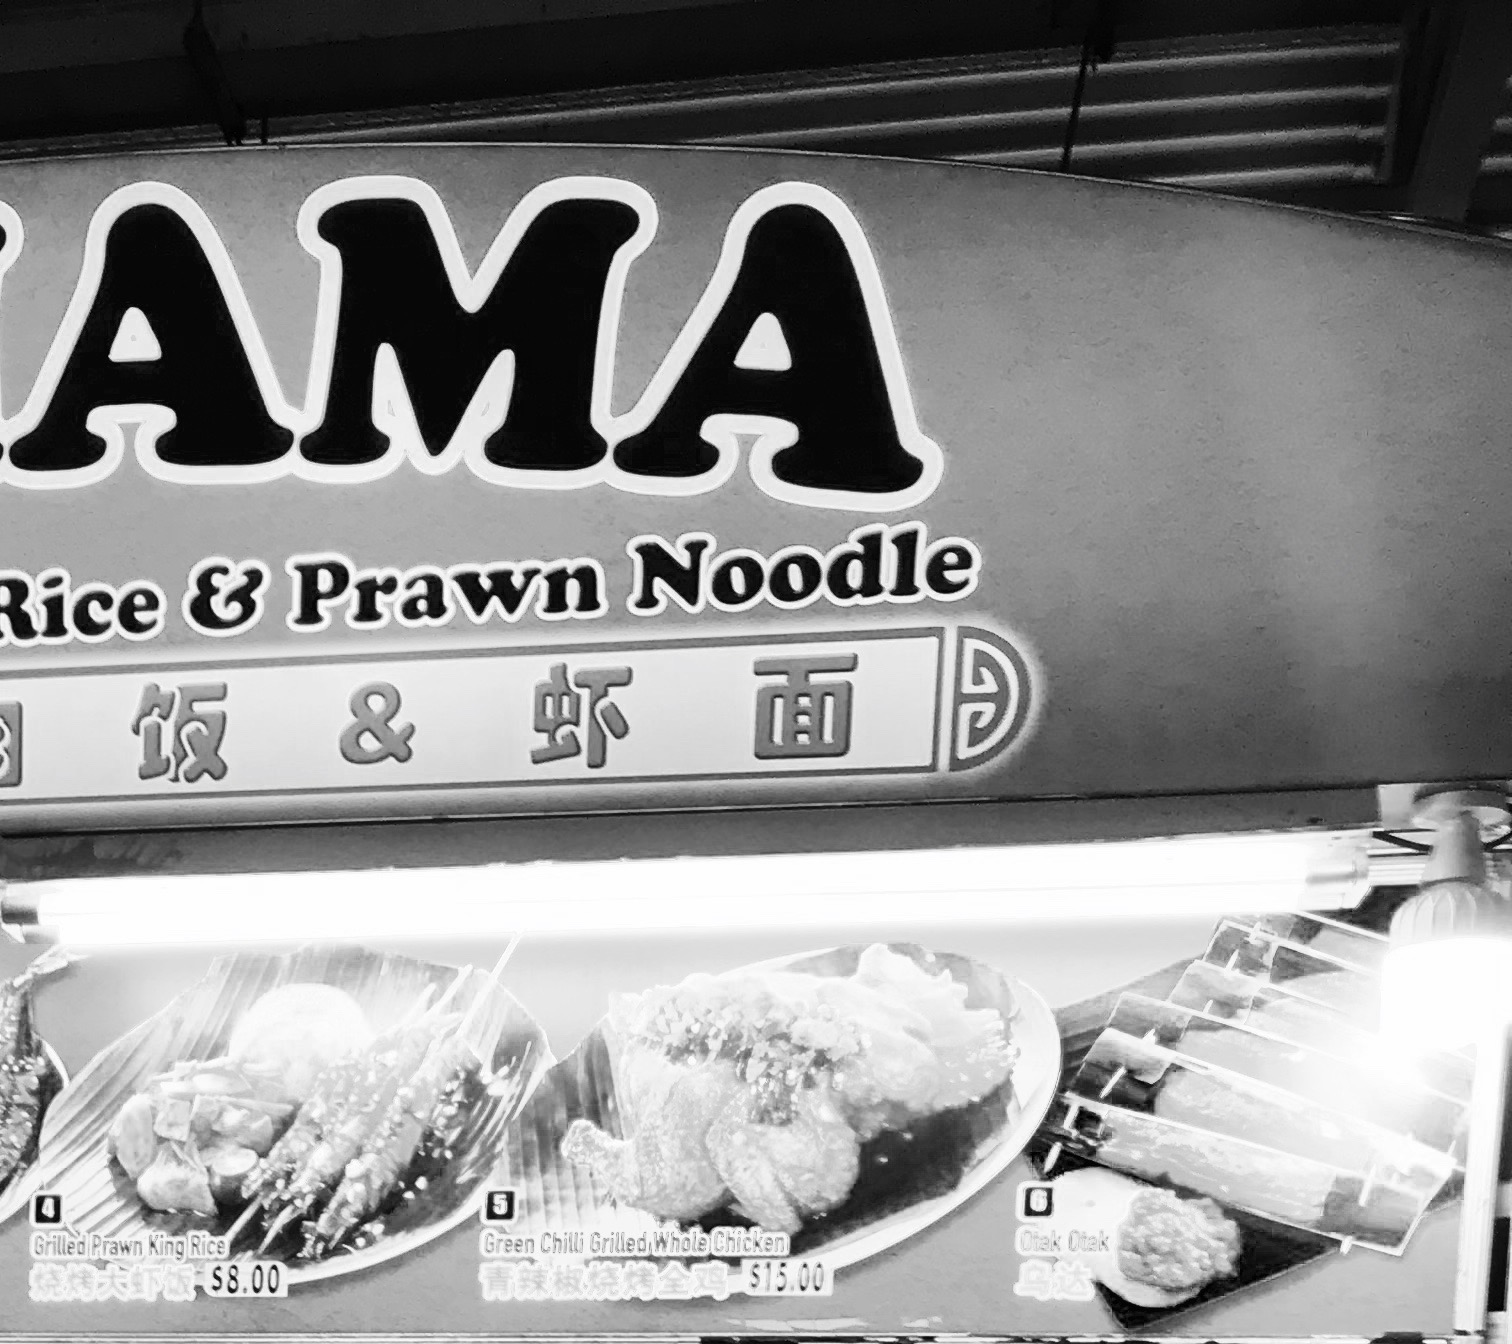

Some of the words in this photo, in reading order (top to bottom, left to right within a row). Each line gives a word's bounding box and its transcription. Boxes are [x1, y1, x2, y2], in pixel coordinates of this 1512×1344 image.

[188, 564, 265, 629] &
[294, 560, 602, 623] Prawn
[630, 529, 974, 609] Noodle
[34, 1235, 86, 1257] Grilled
[92, 1235, 142, 1257] Prawn
[148, 1235, 185, 1262] King
[191, 1234, 226, 1257] Rice
[484, 1232, 534, 1254] Green
[540, 1230, 584, 1254] Chilli
[590, 1230, 647, 1254] Grilled
[652, 1230, 707, 1253] Whole
[713, 1230, 785, 1253] Chicken
[1020, 1229, 1061, 1251] Otak
[1068, 1229, 1109, 1251] Otak
[211, 1263, 280, 1295] $8.00
[748, 1261, 824, 1293] $15.00
